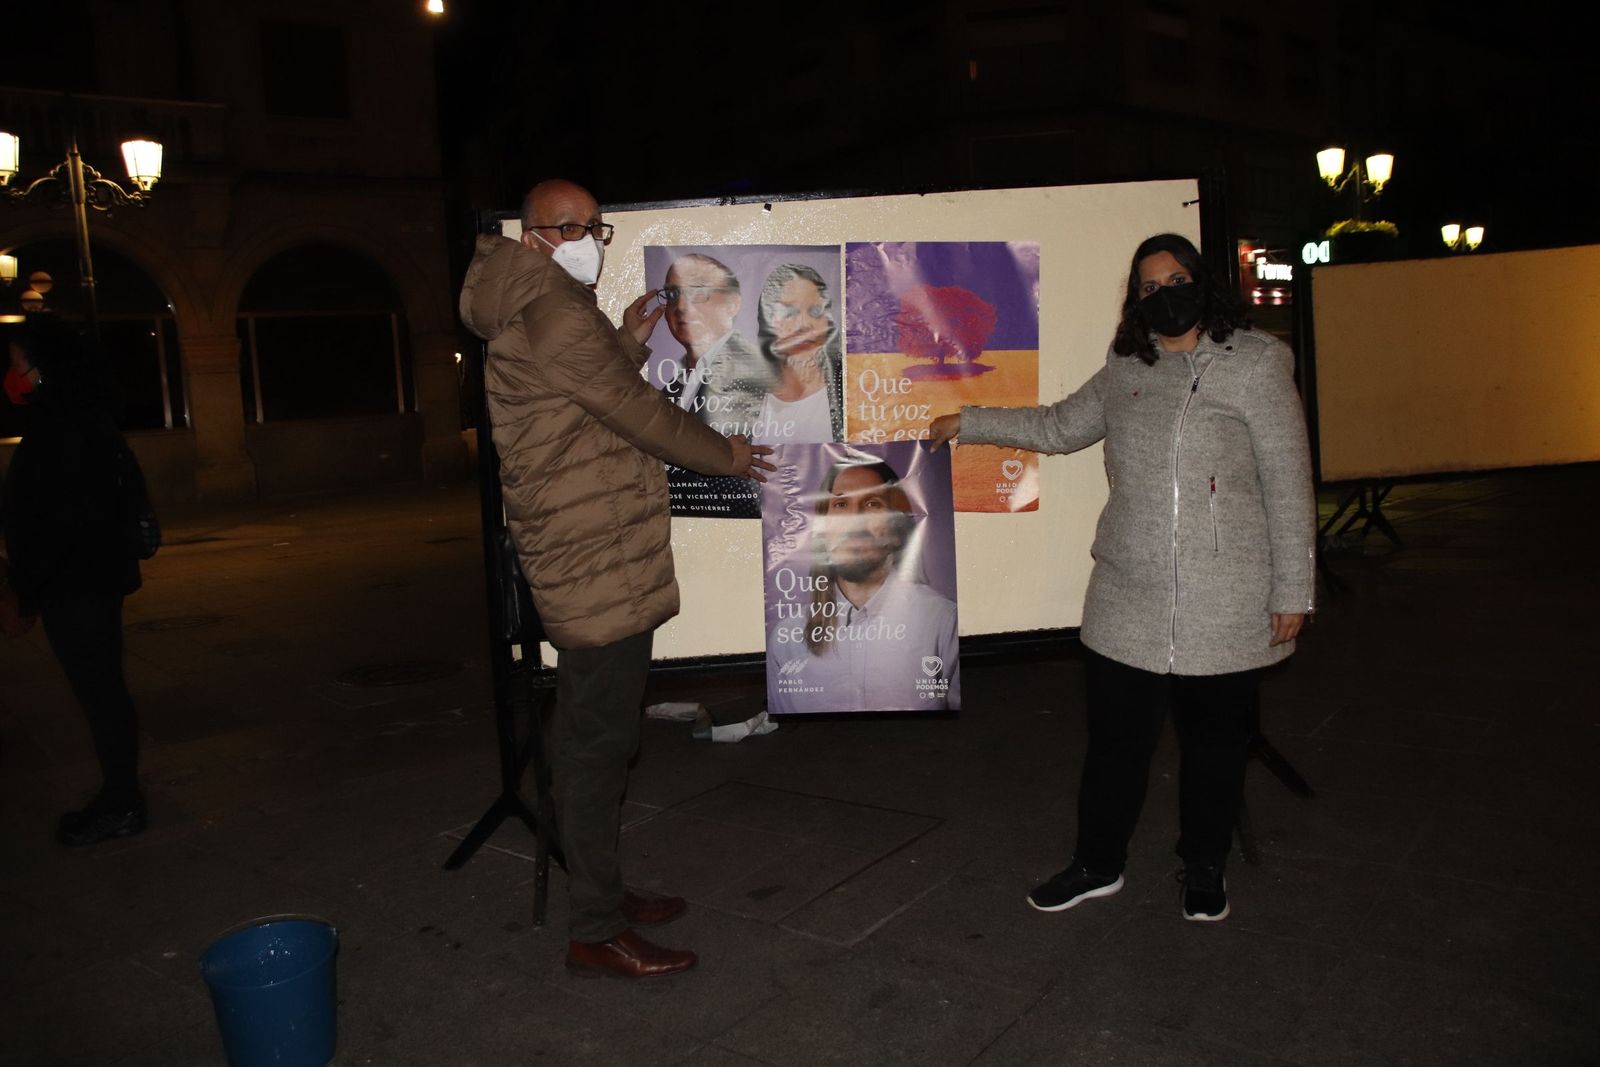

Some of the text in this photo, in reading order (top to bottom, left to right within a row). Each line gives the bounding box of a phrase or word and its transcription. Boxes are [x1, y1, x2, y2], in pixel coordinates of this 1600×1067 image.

[657, 358, 713, 393] Que
[859, 369, 912, 402] Que
[693, 395, 733, 413] voz
[859, 401, 931, 421] tu voz
[709, 411, 795, 438] scuche
[860, 428, 886, 444] se
[722, 492, 758, 500] DELGADO
[775, 567, 829, 600] Que
[775, 599, 850, 619] tu voz
[777, 615, 906, 643] se escuche
